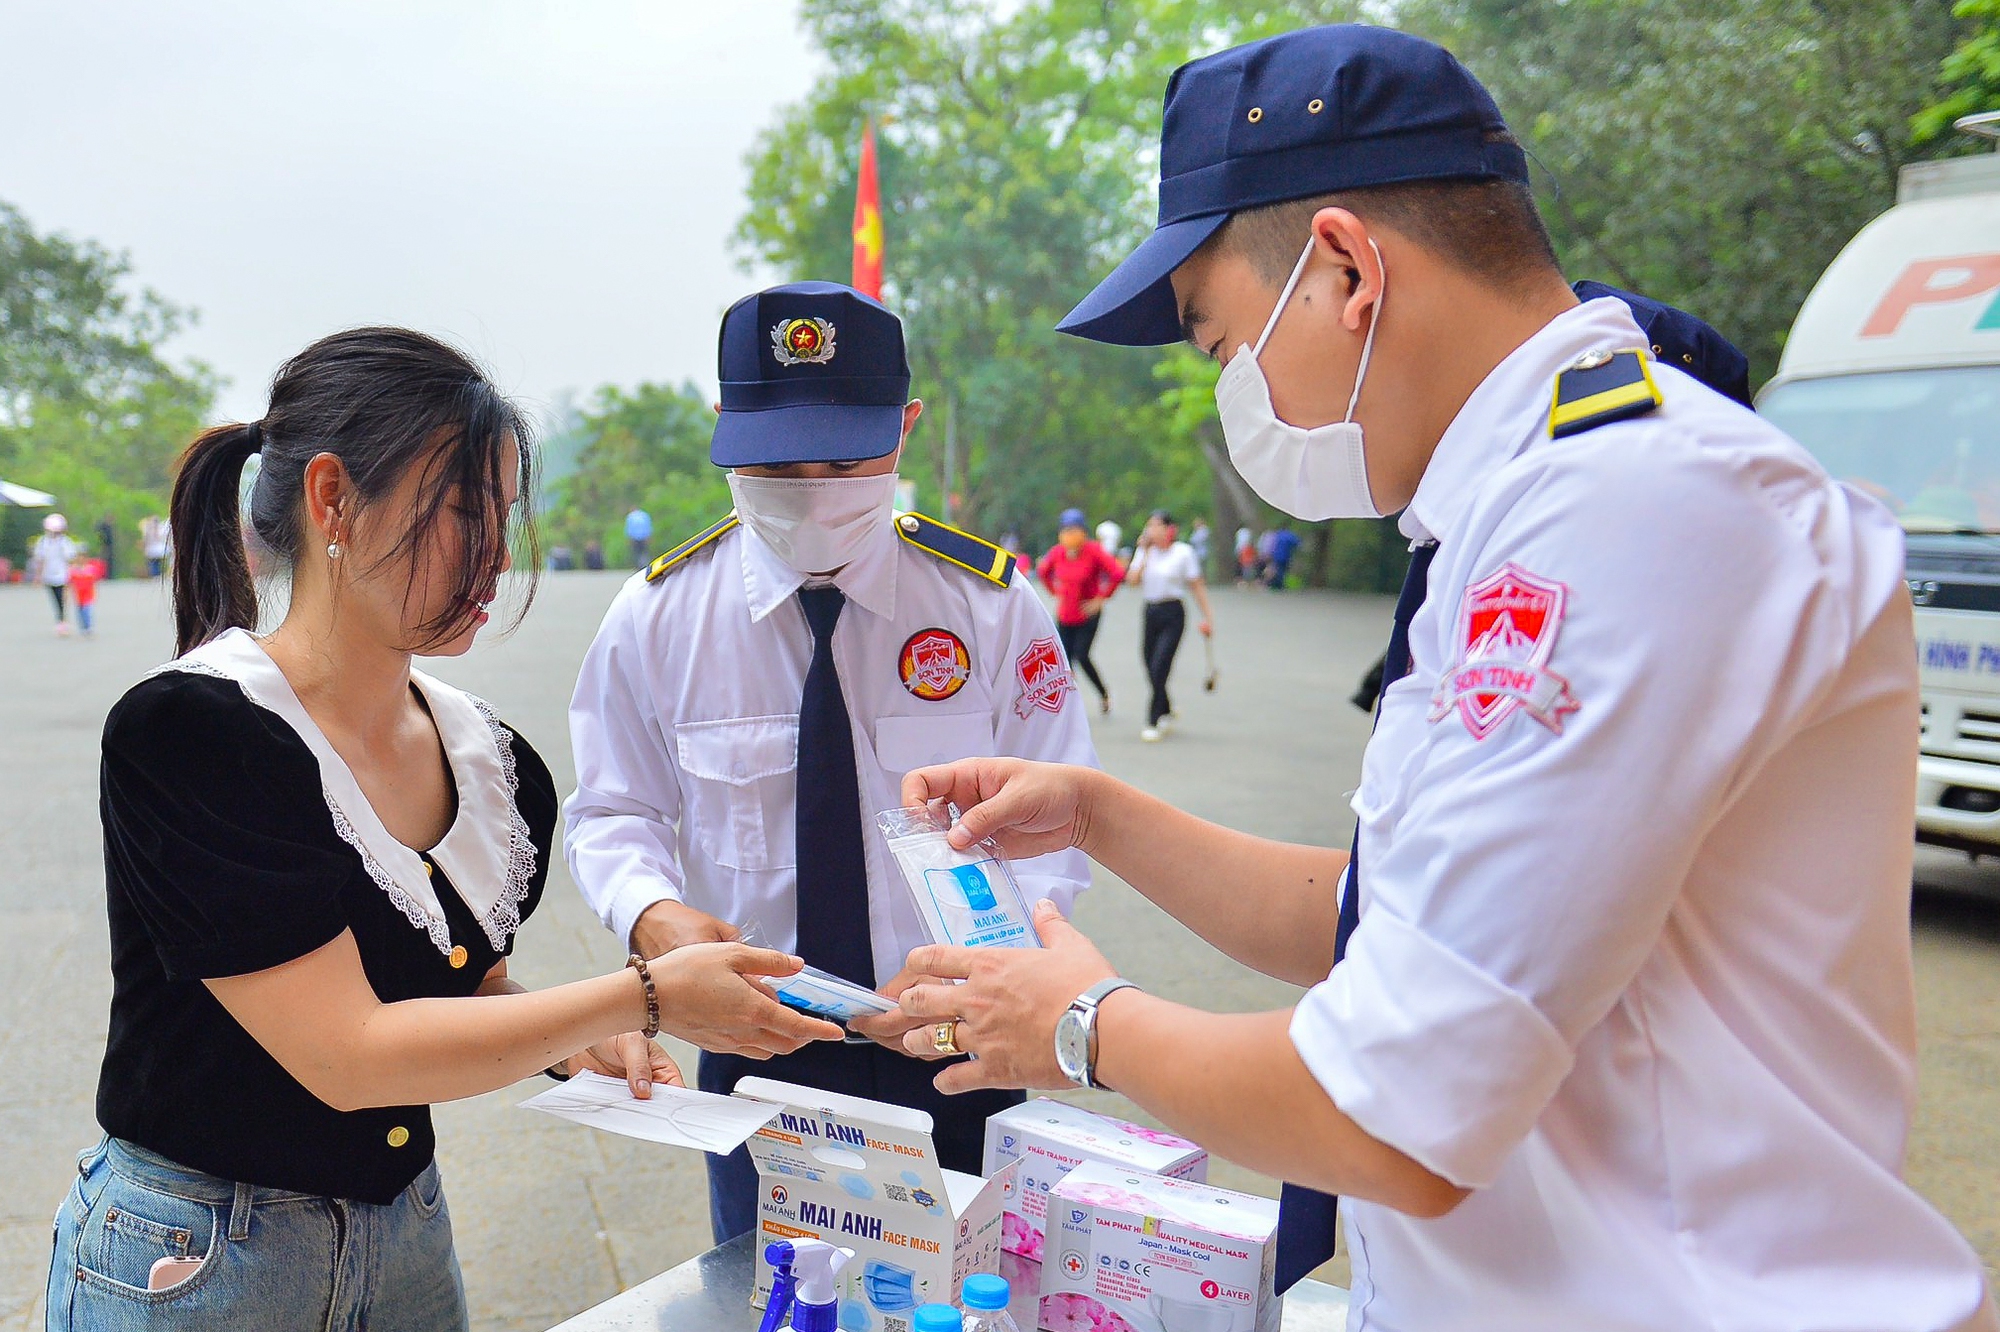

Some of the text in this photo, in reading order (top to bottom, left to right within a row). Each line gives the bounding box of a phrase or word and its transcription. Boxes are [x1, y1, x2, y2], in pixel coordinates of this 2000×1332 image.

[973, 912, 1009, 929] MAI ANH
[779, 1113, 925, 1158] MAI ANH FACE MASK
[1046, 1151, 1067, 1162] TRANG
[800, 1201, 941, 1254] MAI ANH FACE MASK
[1138, 1238, 1162, 1249] Japan
[1168, 1245, 1191, 1257] Mask
[1192, 1251, 1210, 1261] Cool
[1188, 1240, 1224, 1254] MEDICAL
[1225, 1249, 1249, 1260] MASK
[1134, 1263, 1151, 1277] CE
[1205, 1284, 1250, 1301] 4 LAYER
